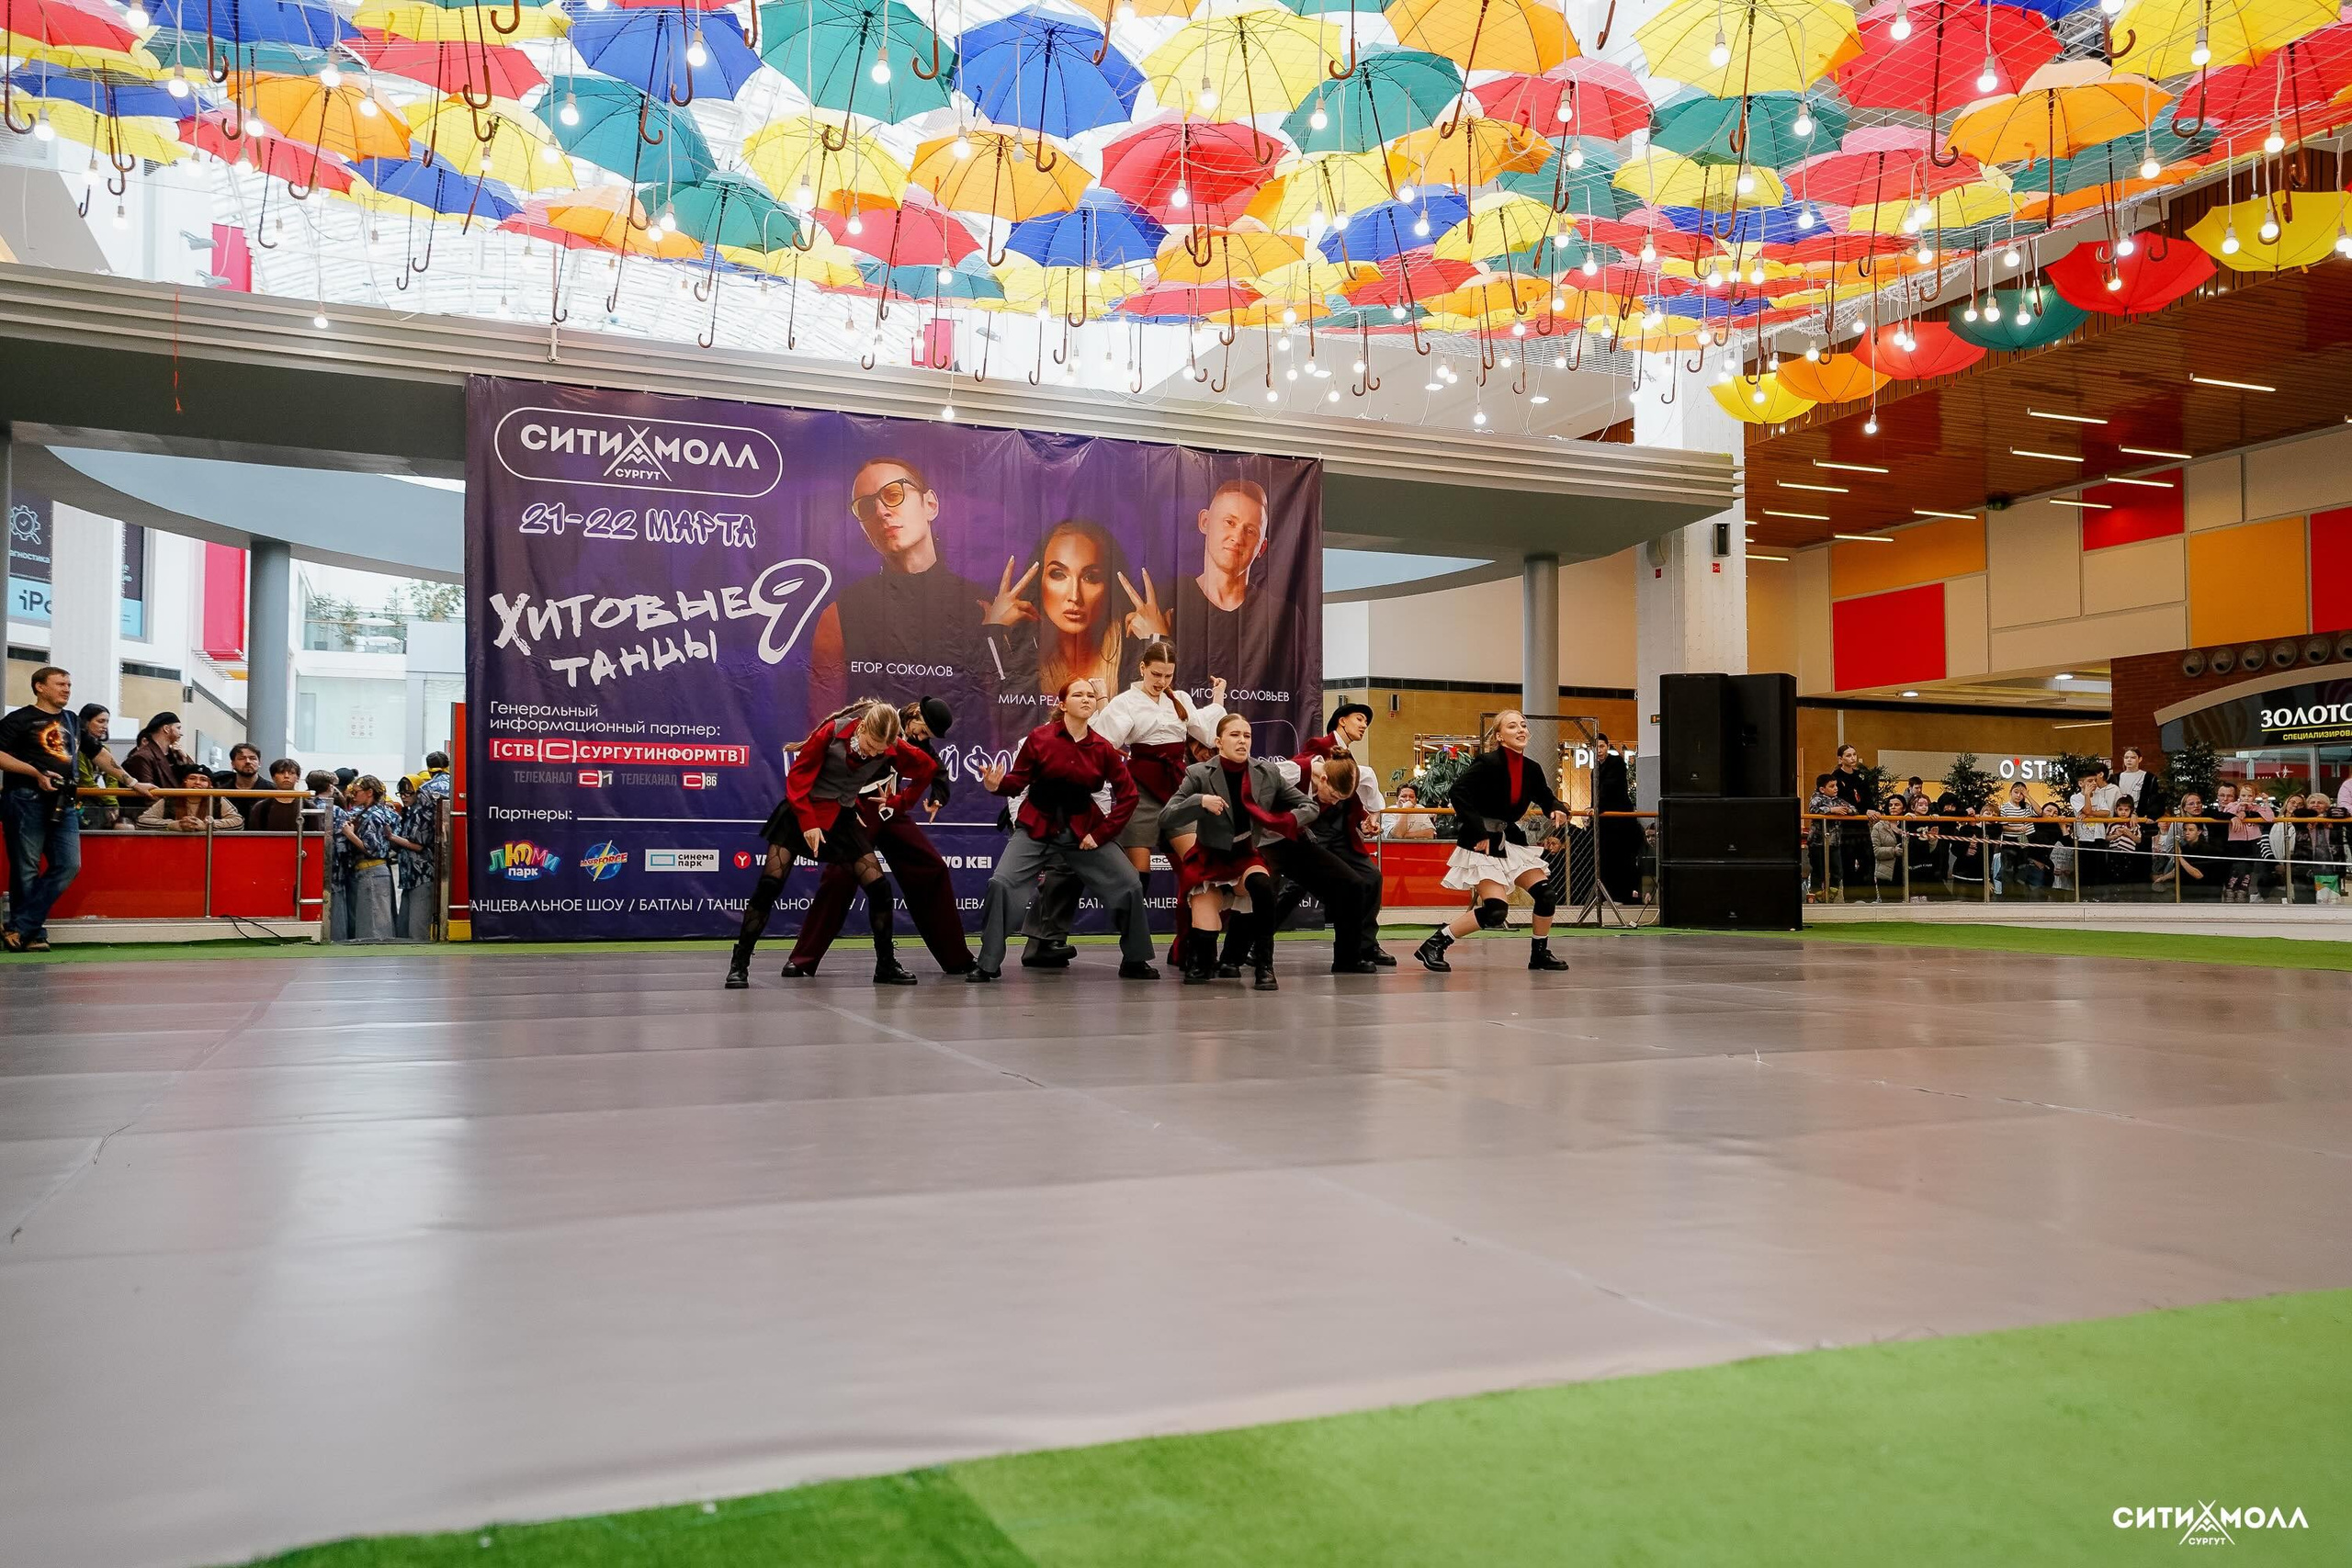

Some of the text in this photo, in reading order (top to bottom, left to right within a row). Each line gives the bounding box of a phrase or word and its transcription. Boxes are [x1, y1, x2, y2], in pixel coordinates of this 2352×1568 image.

[520, 423, 760, 470] СИТИ МОЛЛ
[615, 467, 662, 481] СУРГУТ
[519, 502, 757, 549] 21-22 МАРТА
[851, 661, 954, 677] ЕГОР СОКОЛОВ
[998, 694, 1036, 705] МИЛА
[1230, 689, 1290, 702] СОЛОВЬЕВ
[490, 701, 599, 718] Генеральный
[490, 716, 720, 739] информационный партнер:
[2282, 729, 2352, 741] СПЕЦИАЛИЗИРОВ
[514, 770, 573, 785] ТЕЛЕКАНАЛ
[620, 773, 678, 787] ТЕЛЕКАНАЛ
[489, 806, 573, 821] Партнеры:
[677, 860, 703, 868] парк
[508, 867, 538, 878] парк
[586, 898, 625, 911] ШОУ
[639, 898, 694, 911] БАТТЛЫ
